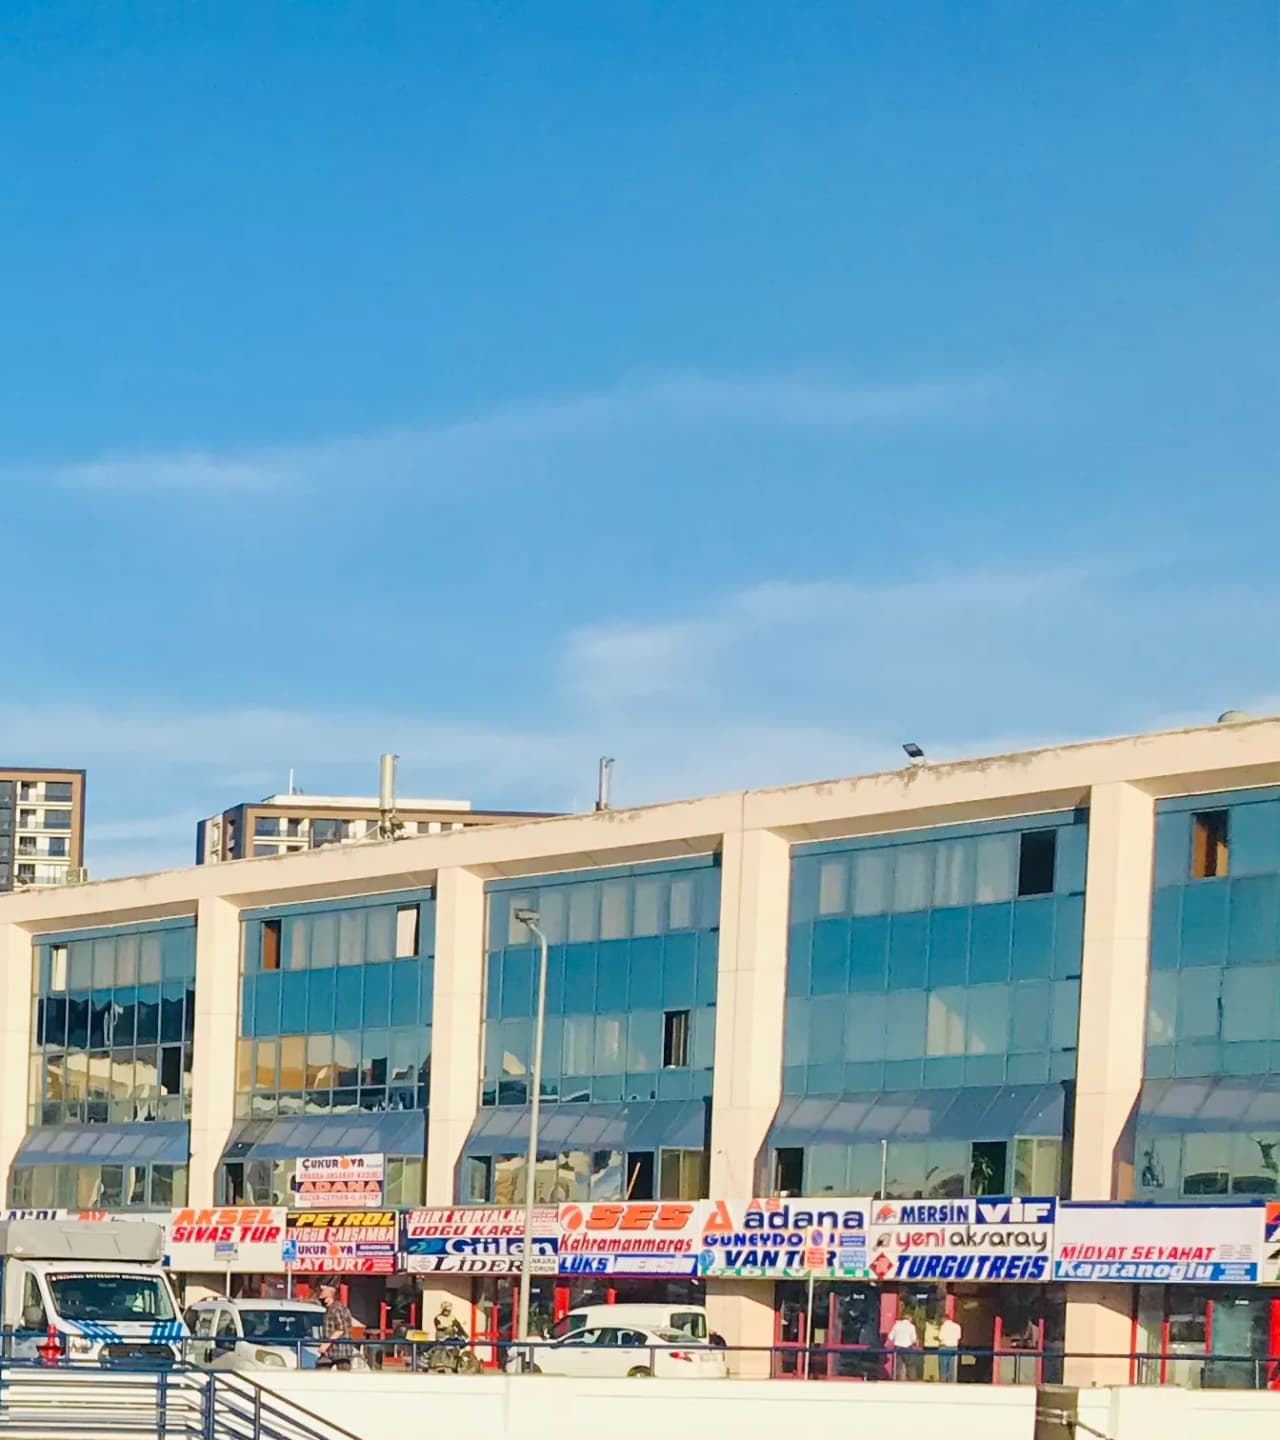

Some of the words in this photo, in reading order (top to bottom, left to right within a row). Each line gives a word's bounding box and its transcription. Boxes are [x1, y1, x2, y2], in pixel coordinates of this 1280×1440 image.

[299, 1180, 381, 1193] ADANA
[173, 1209, 275, 1226] AKSEL
[295, 1212, 395, 1227] PETROL
[585, 1203, 696, 1231] SES
[743, 1204, 865, 1230] adana
[236, 1226, 282, 1244] TUR
[472, 1224, 527, 1237] KARS
[950, 1225, 1048, 1253] aksaray
[444, 1237, 555, 1256] Gülen
[1130, 1246, 1216, 1262] SEYAHAT
[724, 1250, 780, 1268] VAN
[1056, 1260, 1214, 1282] Kaptanoğlu
